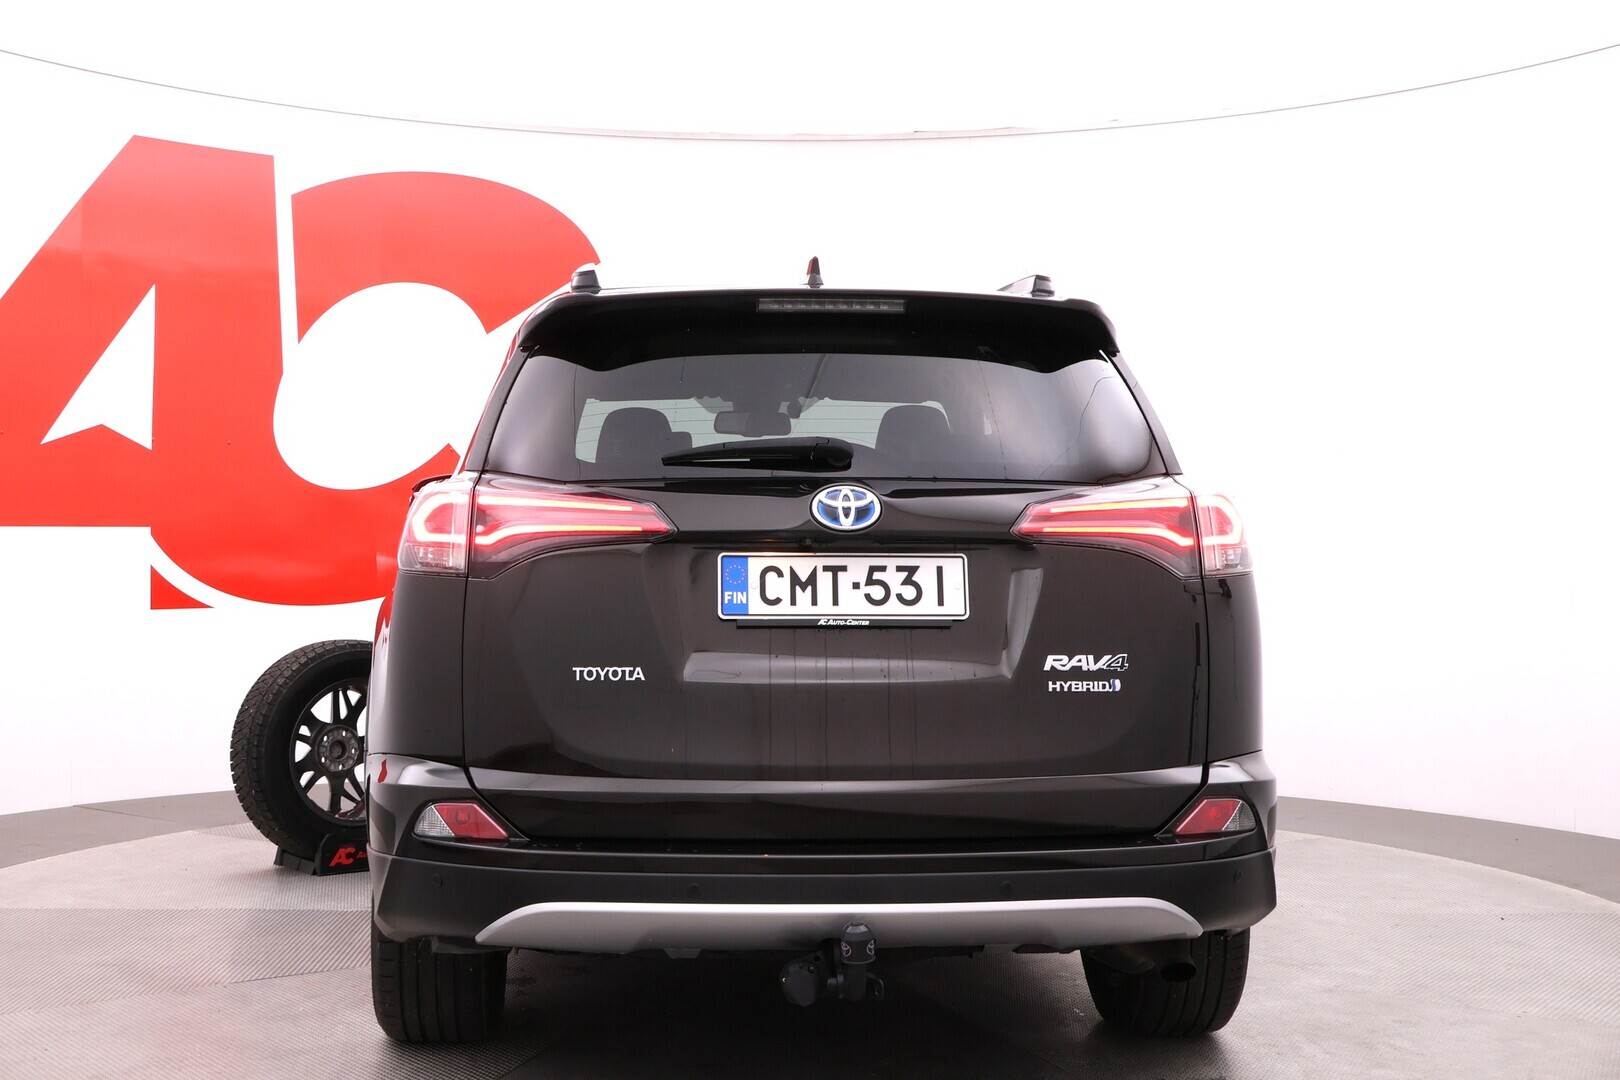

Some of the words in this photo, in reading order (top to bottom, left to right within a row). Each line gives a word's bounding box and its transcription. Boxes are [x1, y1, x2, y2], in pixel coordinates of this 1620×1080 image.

[0, 135, 600, 609] AC
[759, 565, 945, 607] CMT-531
[724, 591, 747, 604] FIN
[1043, 654, 1129, 672] RAV4
[572, 666, 646, 682] TOYOTA
[1048, 680, 1111, 692] HYBRID
[329, 847, 355, 867] AC
